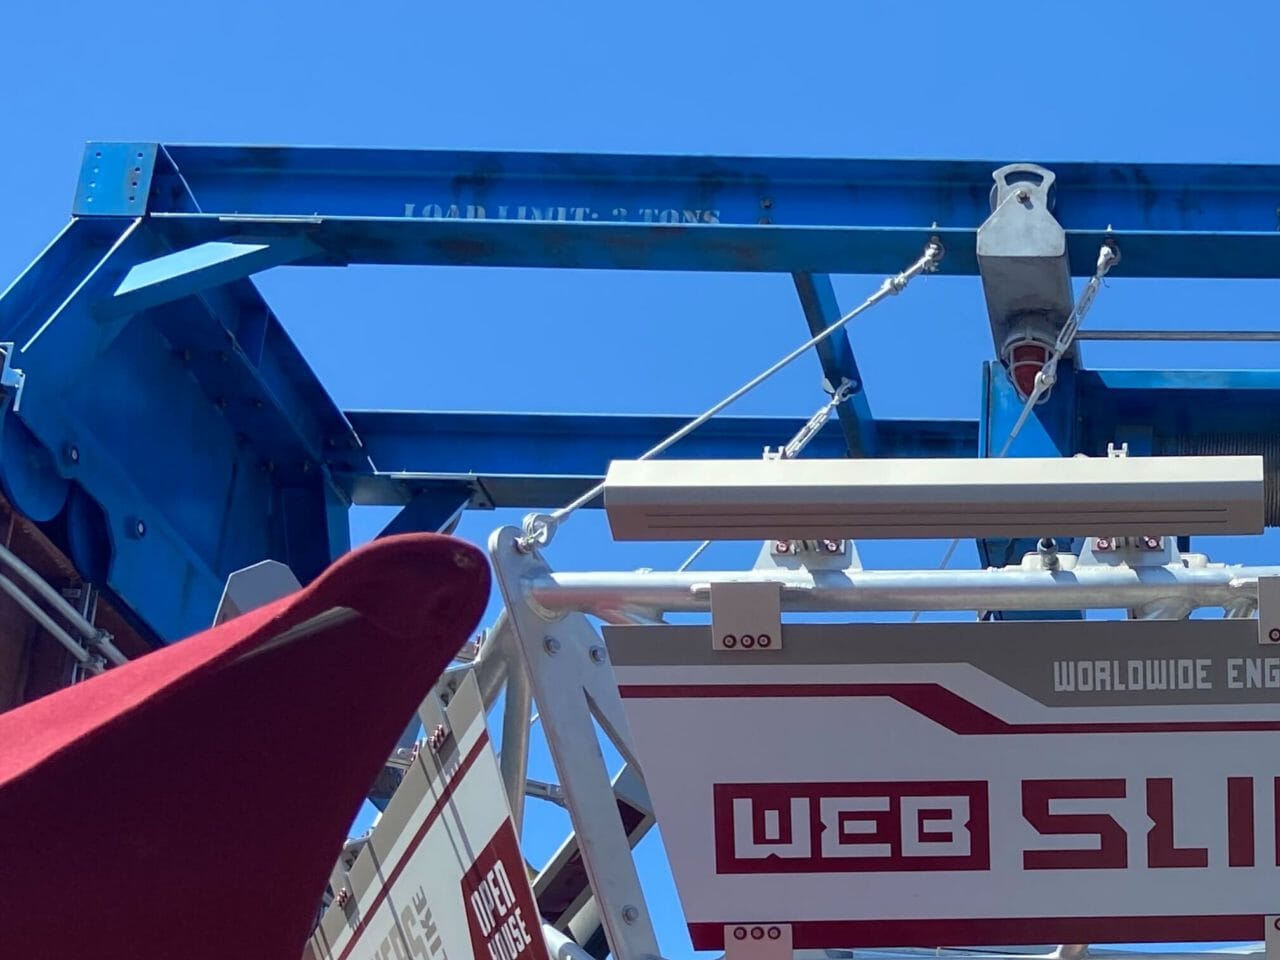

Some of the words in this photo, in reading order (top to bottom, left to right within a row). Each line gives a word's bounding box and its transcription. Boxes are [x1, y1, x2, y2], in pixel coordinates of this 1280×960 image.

[1053, 659, 1213, 692] WORLDWIDE
[728, 791, 977, 864] WEB
[470, 860, 515, 937] OPEN
